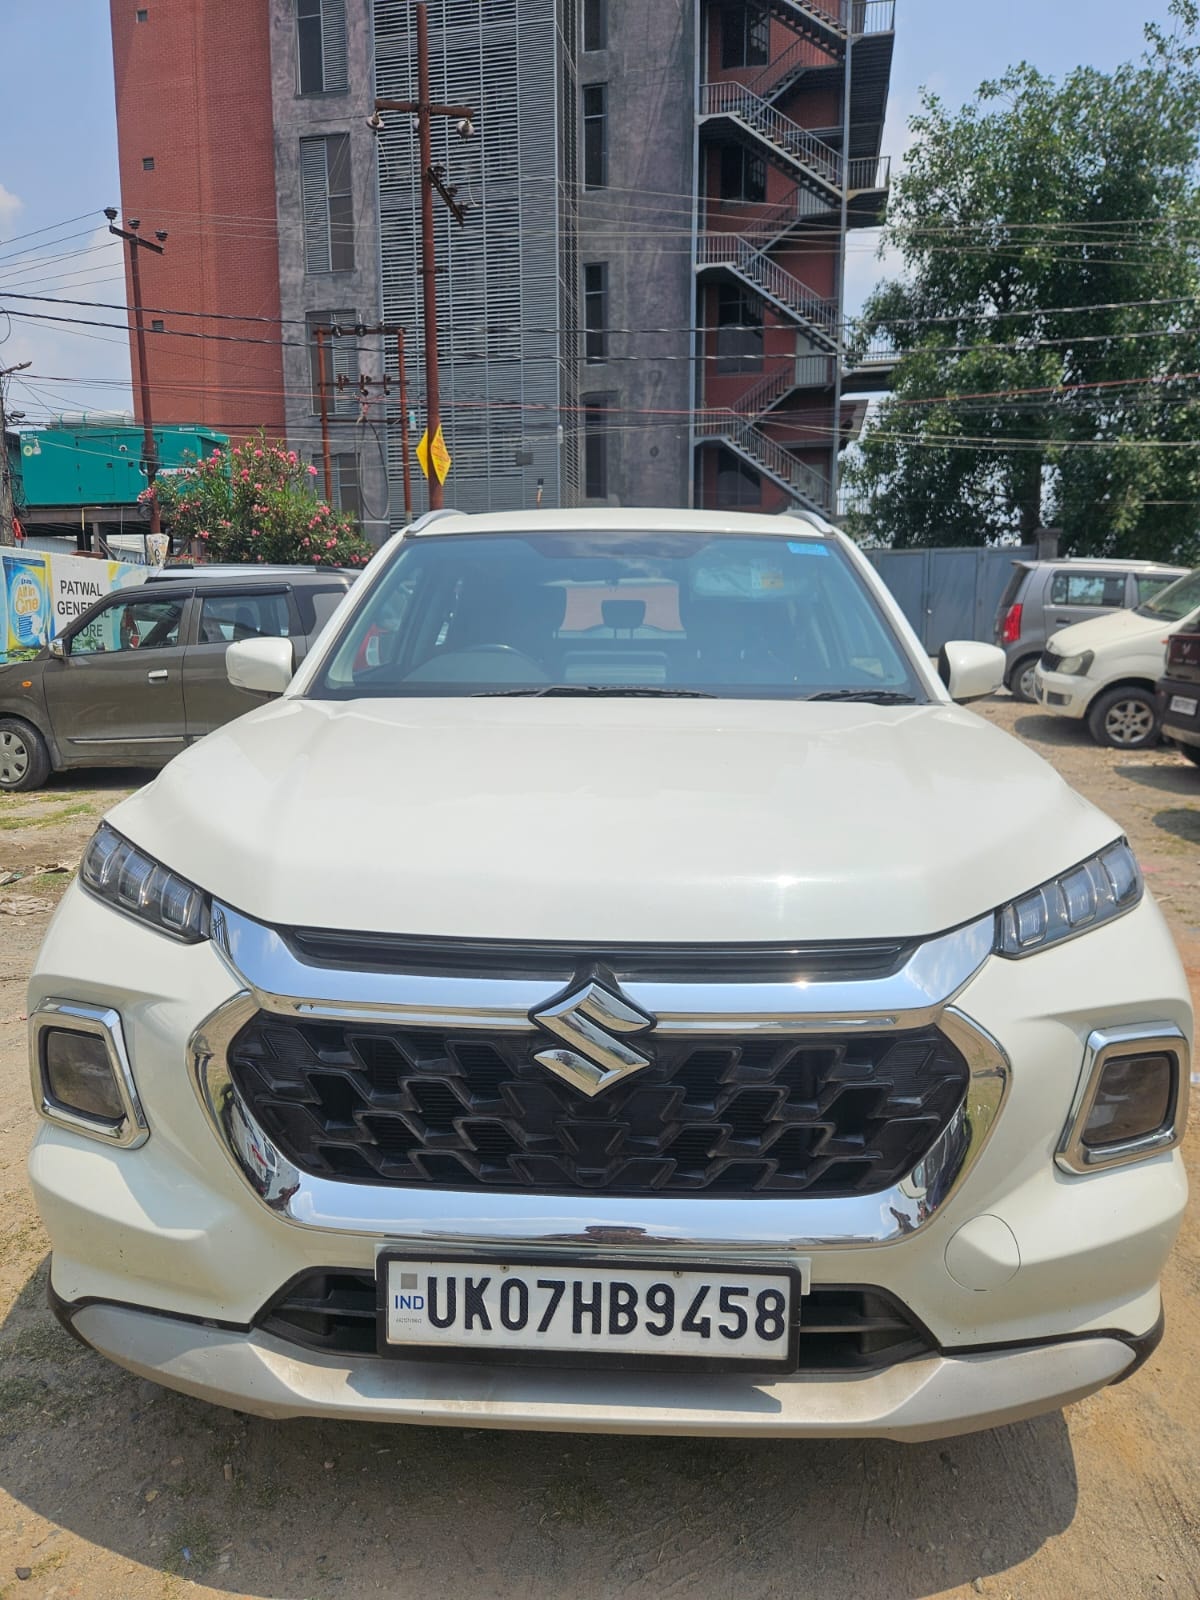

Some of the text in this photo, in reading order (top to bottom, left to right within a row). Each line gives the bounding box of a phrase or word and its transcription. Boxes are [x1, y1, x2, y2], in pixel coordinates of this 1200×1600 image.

[60, 579, 103, 597] PATWAL
[57, 600, 109, 618] GENEL
[395, 1294, 424, 1310] IND
[427, 1276, 786, 1341] UK07HB9458
